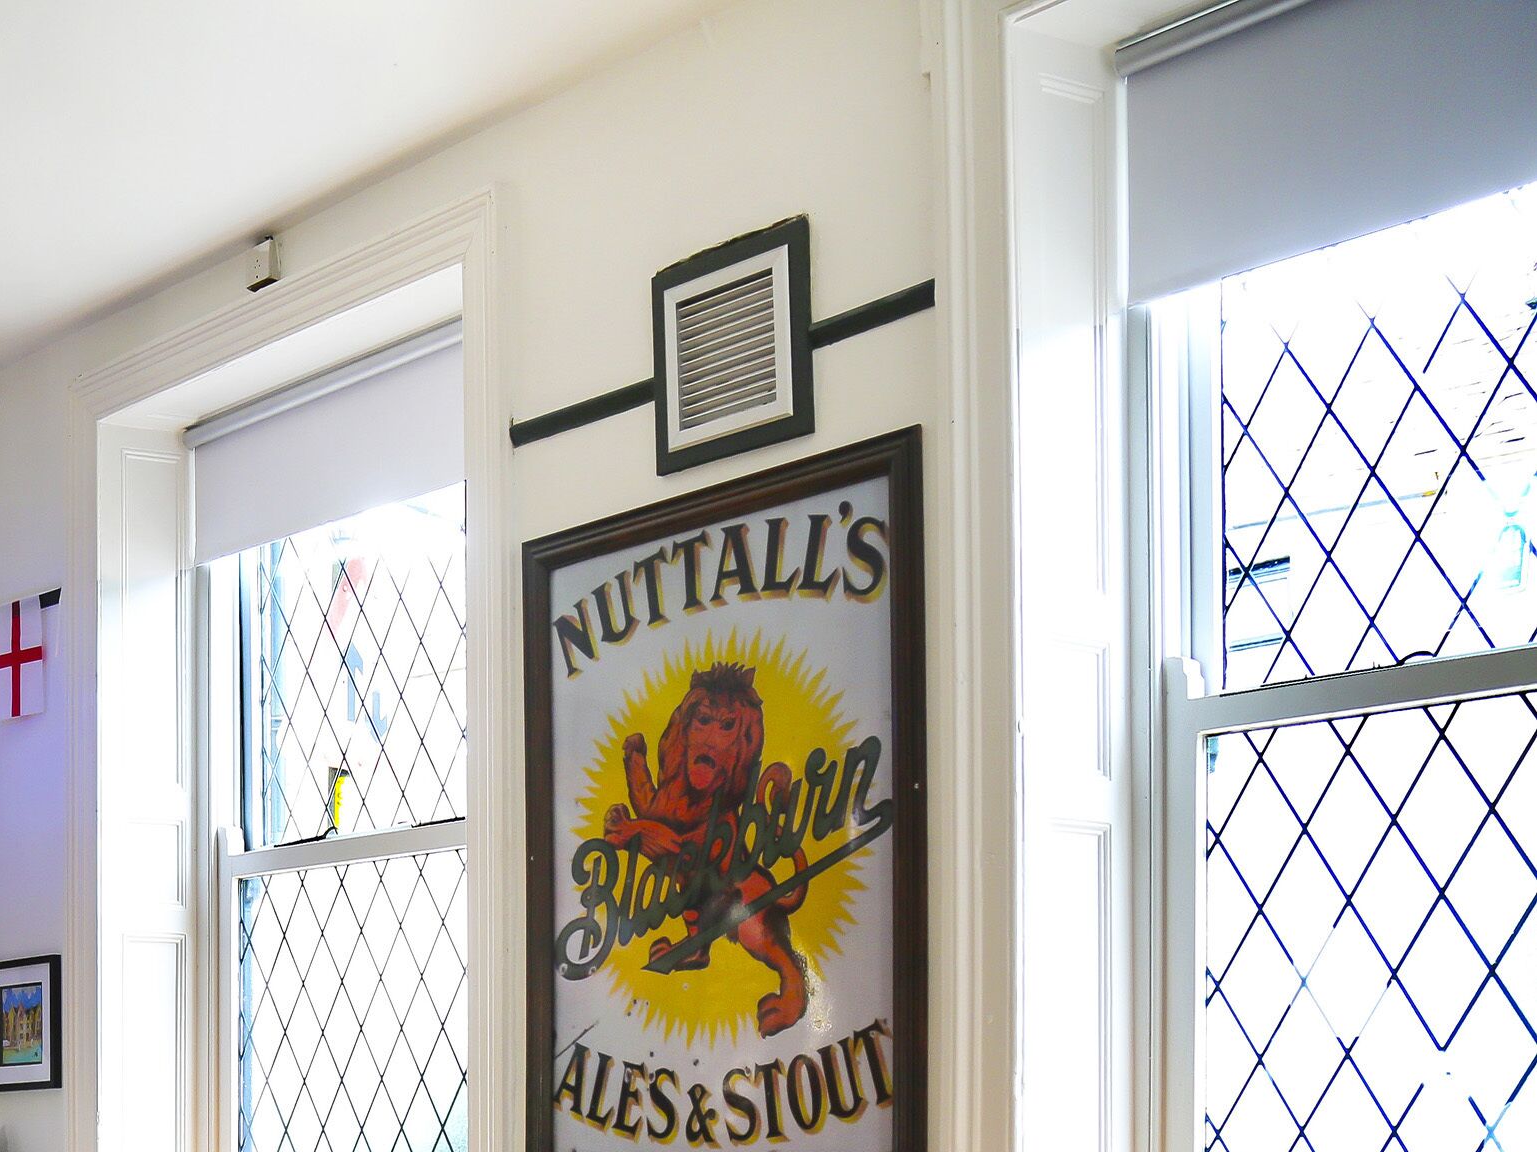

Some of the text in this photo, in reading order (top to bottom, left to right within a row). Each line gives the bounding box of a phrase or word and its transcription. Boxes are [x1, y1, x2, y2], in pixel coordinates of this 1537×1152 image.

[553, 500, 889, 680] NUTTALL'S
[555, 735, 893, 982] Blackburn
[552, 1042, 680, 1145] ALES
[723, 1018, 893, 1146] STOUT
